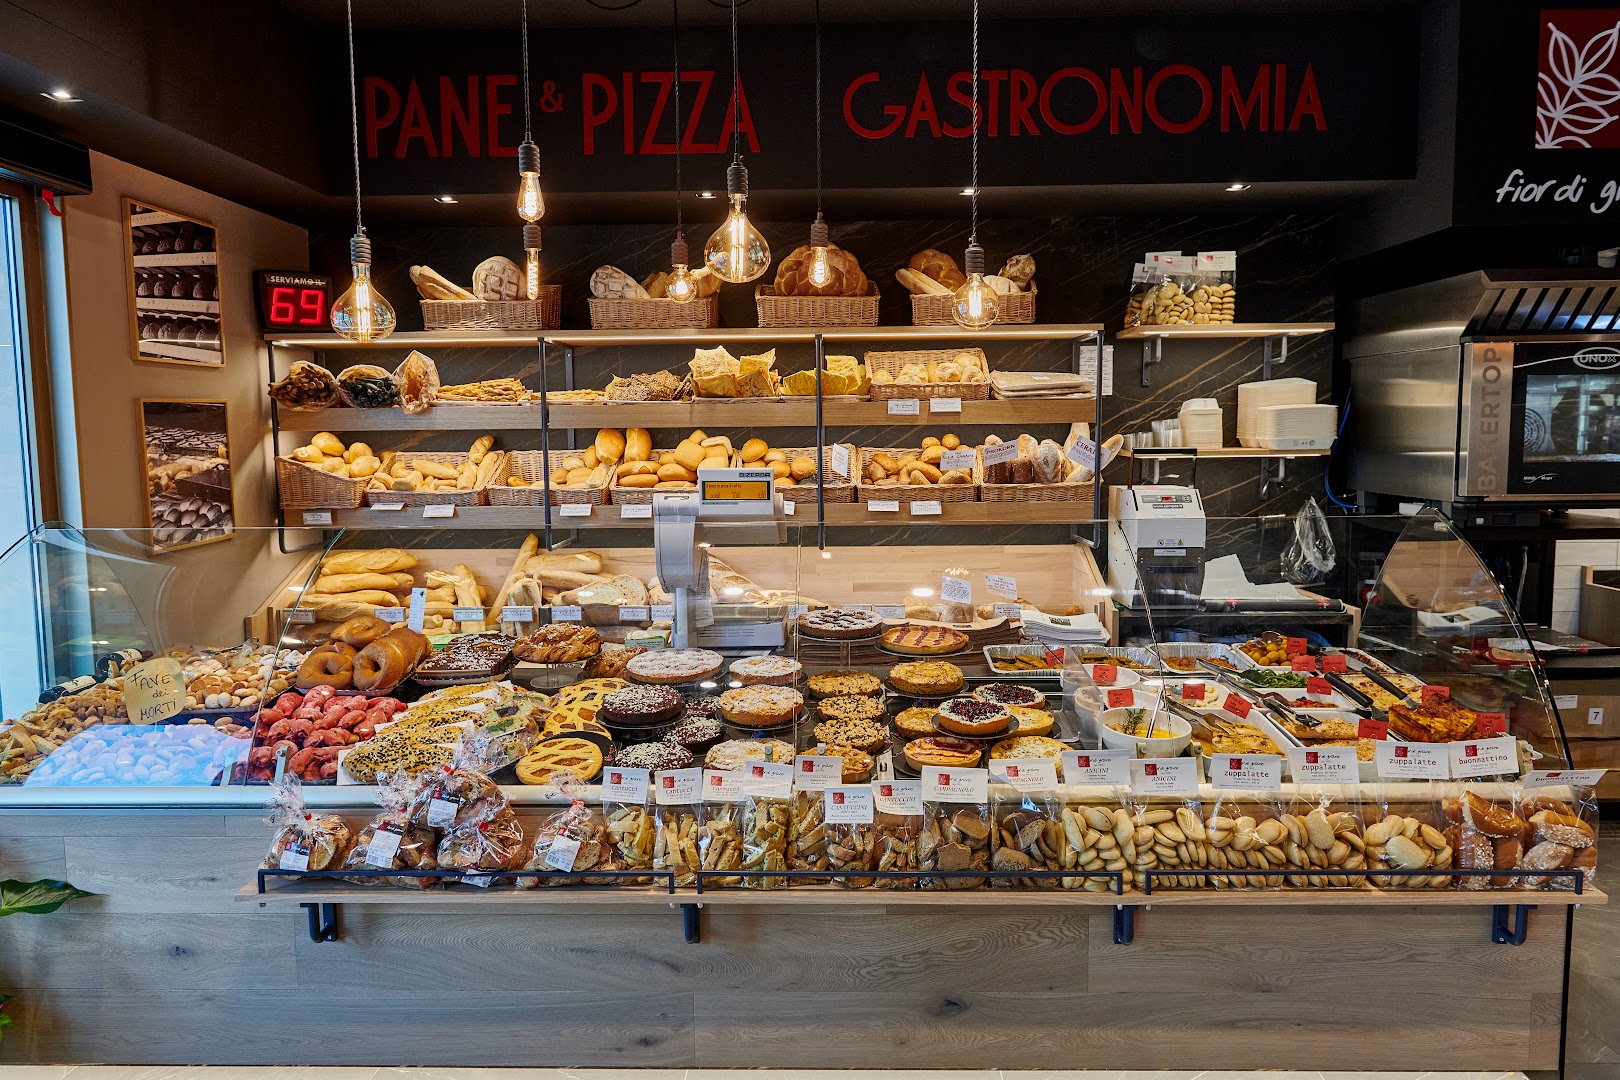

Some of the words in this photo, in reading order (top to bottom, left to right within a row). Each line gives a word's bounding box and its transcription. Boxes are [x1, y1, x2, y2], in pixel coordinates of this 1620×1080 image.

[842, 61, 1328, 139] GASTRONOMIA
[363, 74, 519, 159] PANE
[539, 80, 565, 113] &
[582, 70, 761, 155] PIZZA
[1496, 168, 1557, 203] fior
[1553, 174, 1588, 203] di
[270, 275, 314, 286] SERVIAMO
[271, 287, 324, 324] 69
[1579, 354, 1617, 363] UNOX
[1477, 347, 1502, 492] BAKERTOP
[126, 669, 171, 690] FAVE
[152, 689, 170, 699] dei
[1593, 711, 1600, 721] 7
[1389, 758, 1437, 766] zuppalatte
[1459, 755, 1508, 764] buonmattino
[1301, 763, 1346, 771] zuppalatte
[1224, 770, 1269, 778] zuppalatte
[665, 786, 693, 794] cantucci
